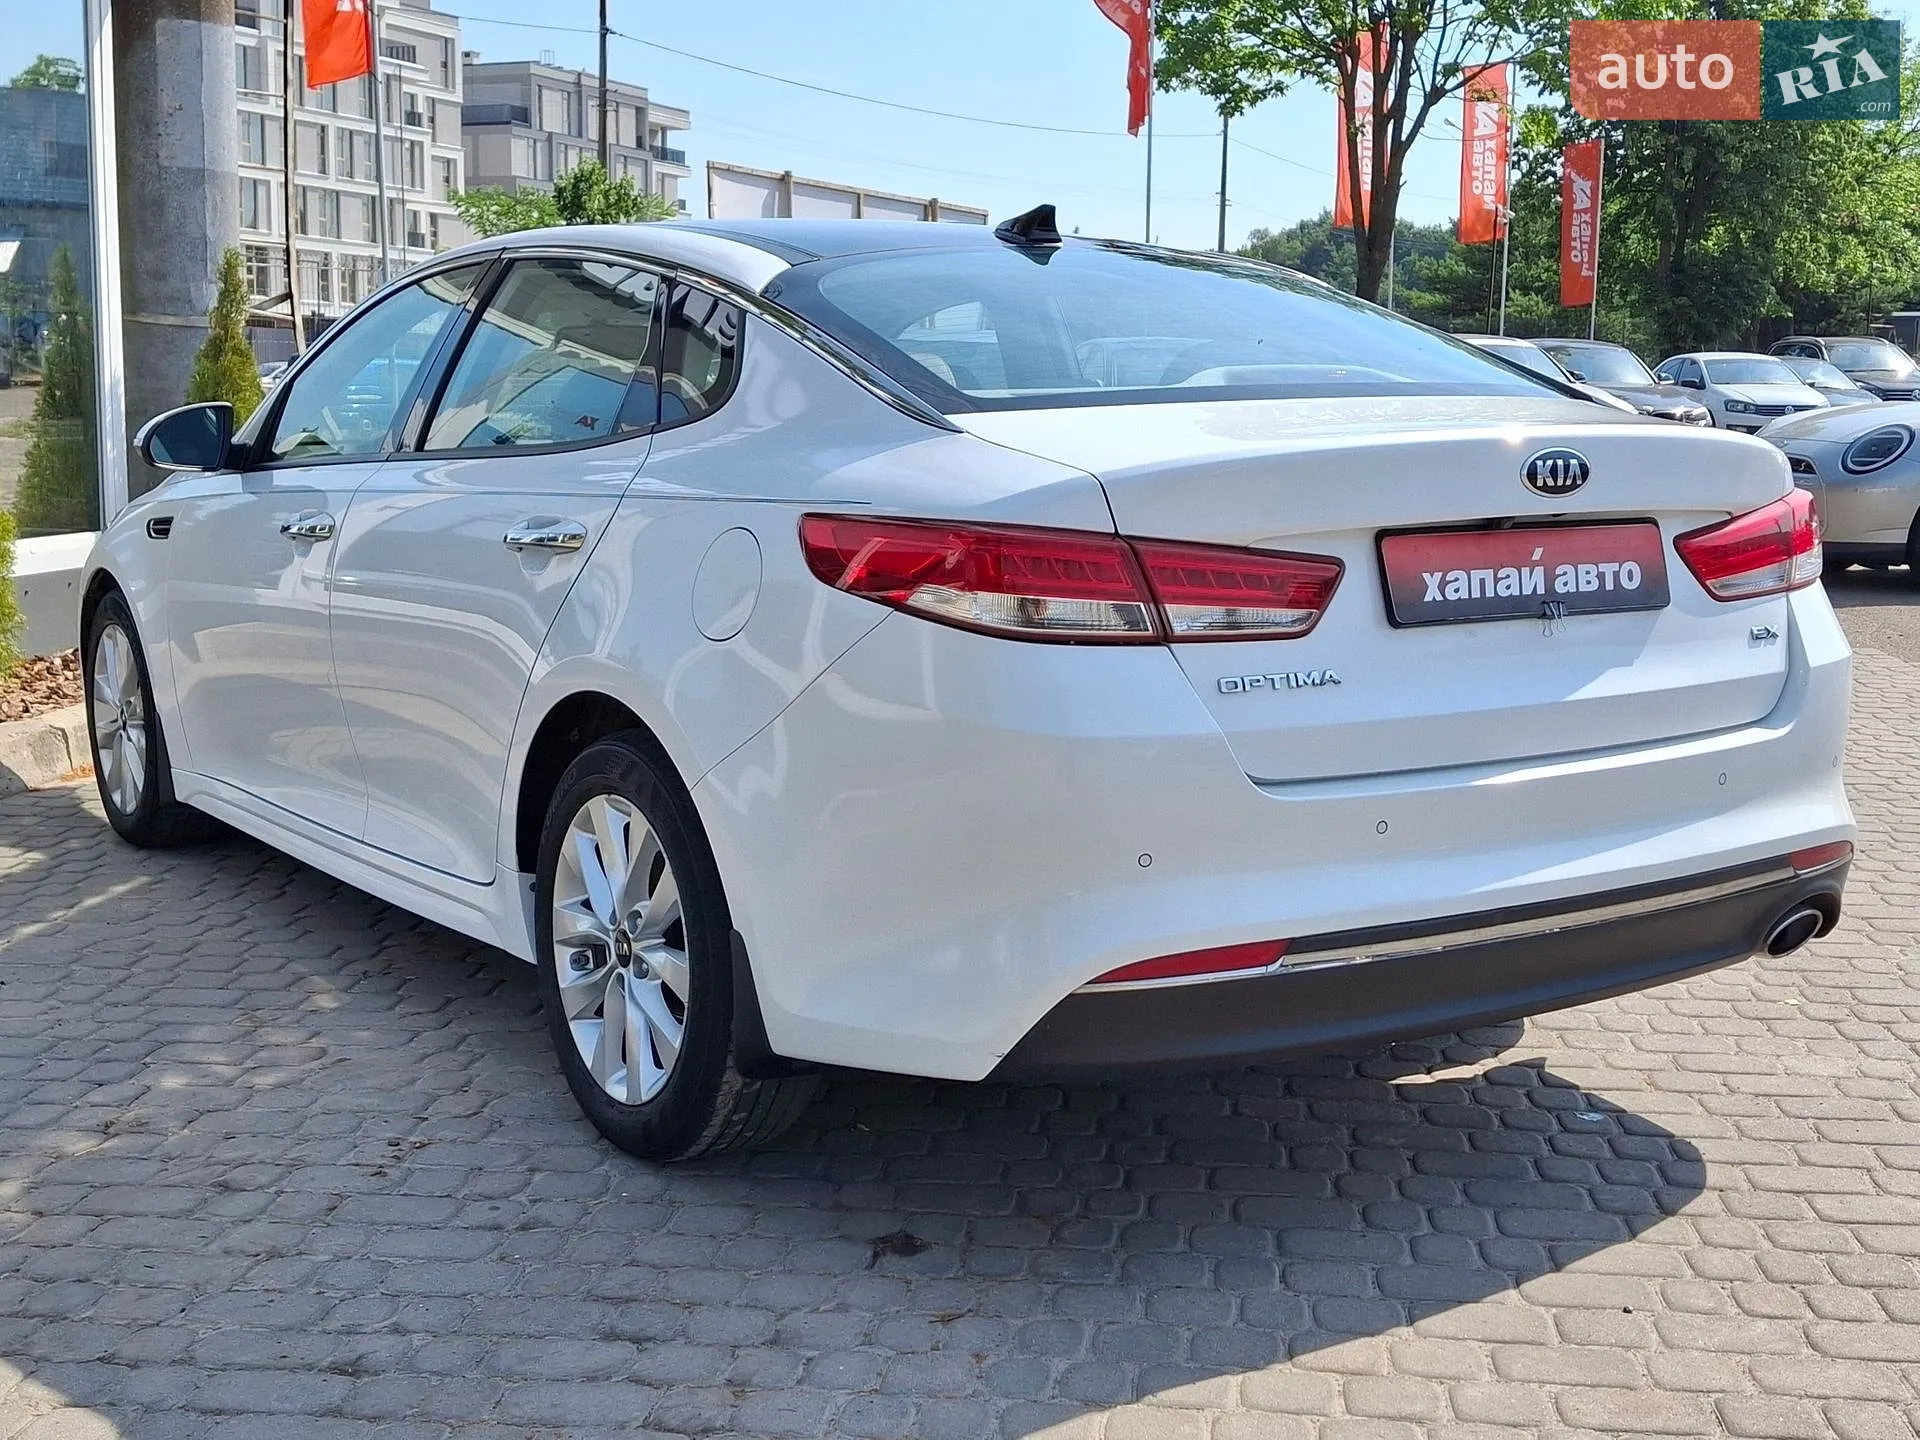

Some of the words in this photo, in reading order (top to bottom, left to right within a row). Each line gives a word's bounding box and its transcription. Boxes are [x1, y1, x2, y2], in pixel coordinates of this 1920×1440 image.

[1472, 139, 1483, 194] авто
[1571, 213, 1581, 263] авто
[1535, 458, 1583, 487] KIA
[1422, 547, 1545, 602] хапай
[1555, 561, 1642, 594] авто
[1750, 624, 1780, 641] EX
[1217, 668, 1342, 694] OPTIMA
